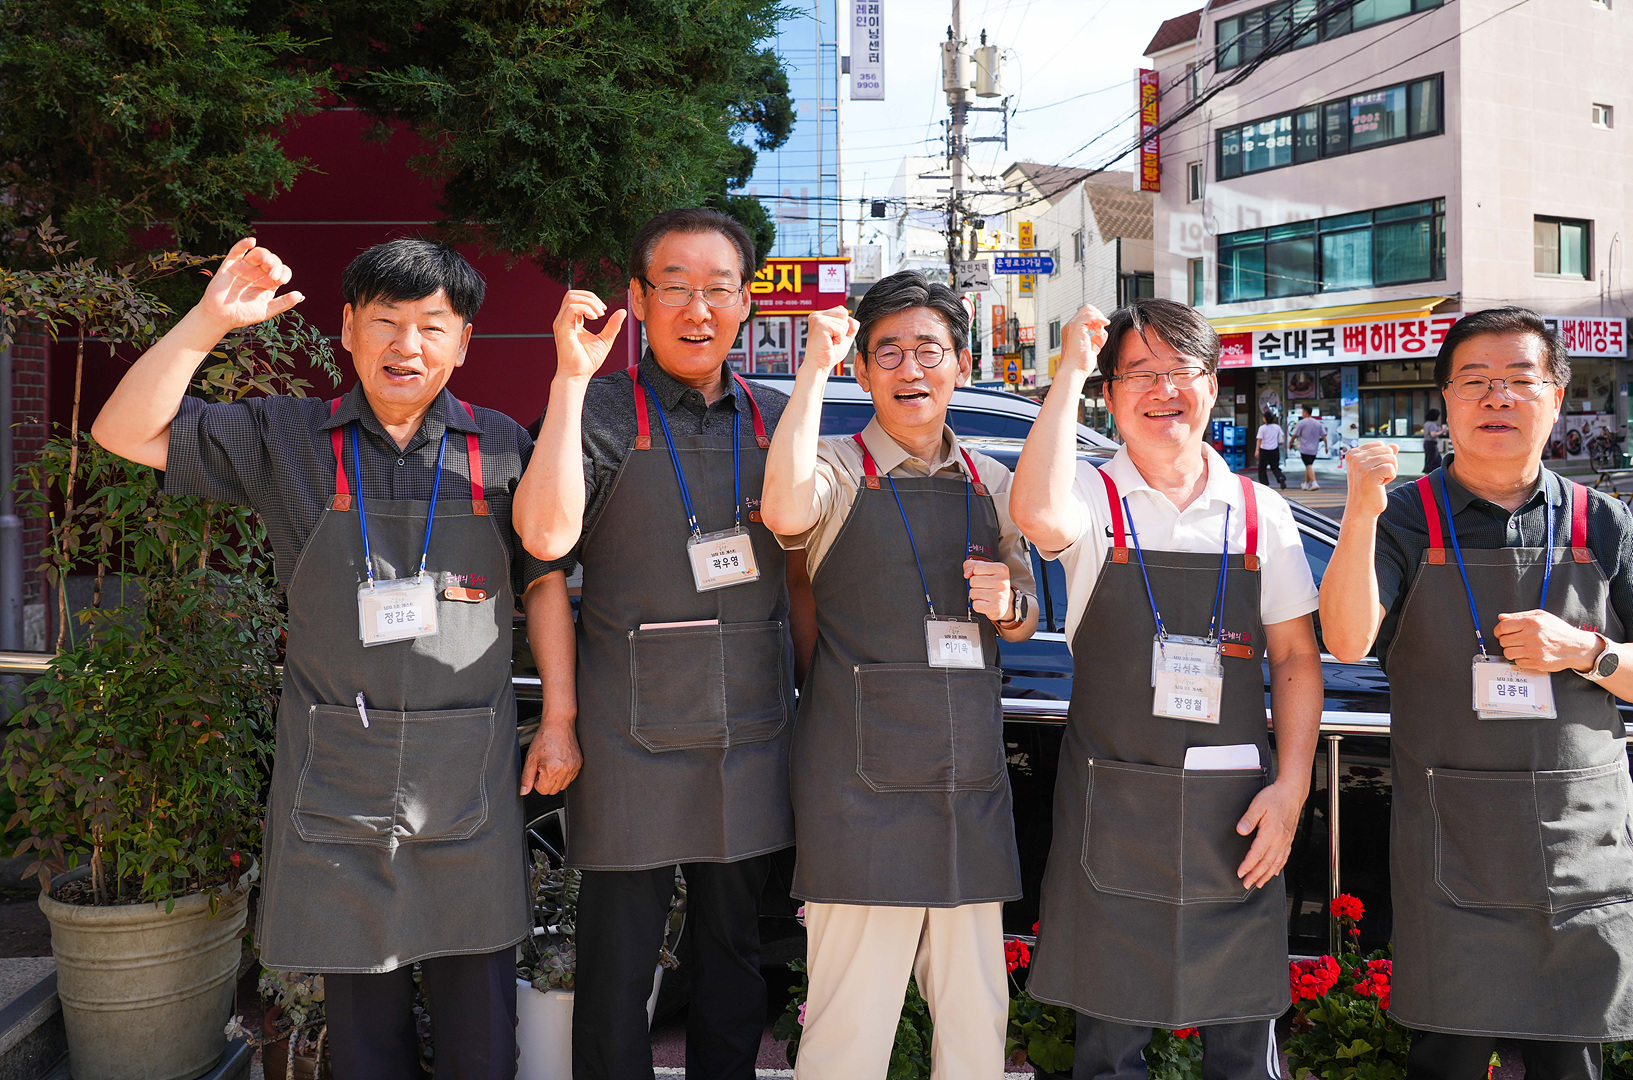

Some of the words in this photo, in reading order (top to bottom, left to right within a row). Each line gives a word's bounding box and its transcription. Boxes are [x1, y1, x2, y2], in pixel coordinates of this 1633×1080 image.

[856, 0, 867, 27] 레인
[868, 0, 880, 63] 레이닝센터
[960, 262, 988, 274] 견인지역
[996, 258, 1041, 268] 은평로3가길
[1562, 319, 1622, 353] 뼈해장국
[1258, 327, 1335, 361] 순대국
[713, 555, 739, 569] 곽우영
[445, 571, 469, 584] 은혜의
[469, 573, 487, 586] 동산
[384, 609, 416, 625] 정갑순
[1496, 684, 1528, 698] 임종태
[1174, 697, 1202, 711] 장영철
